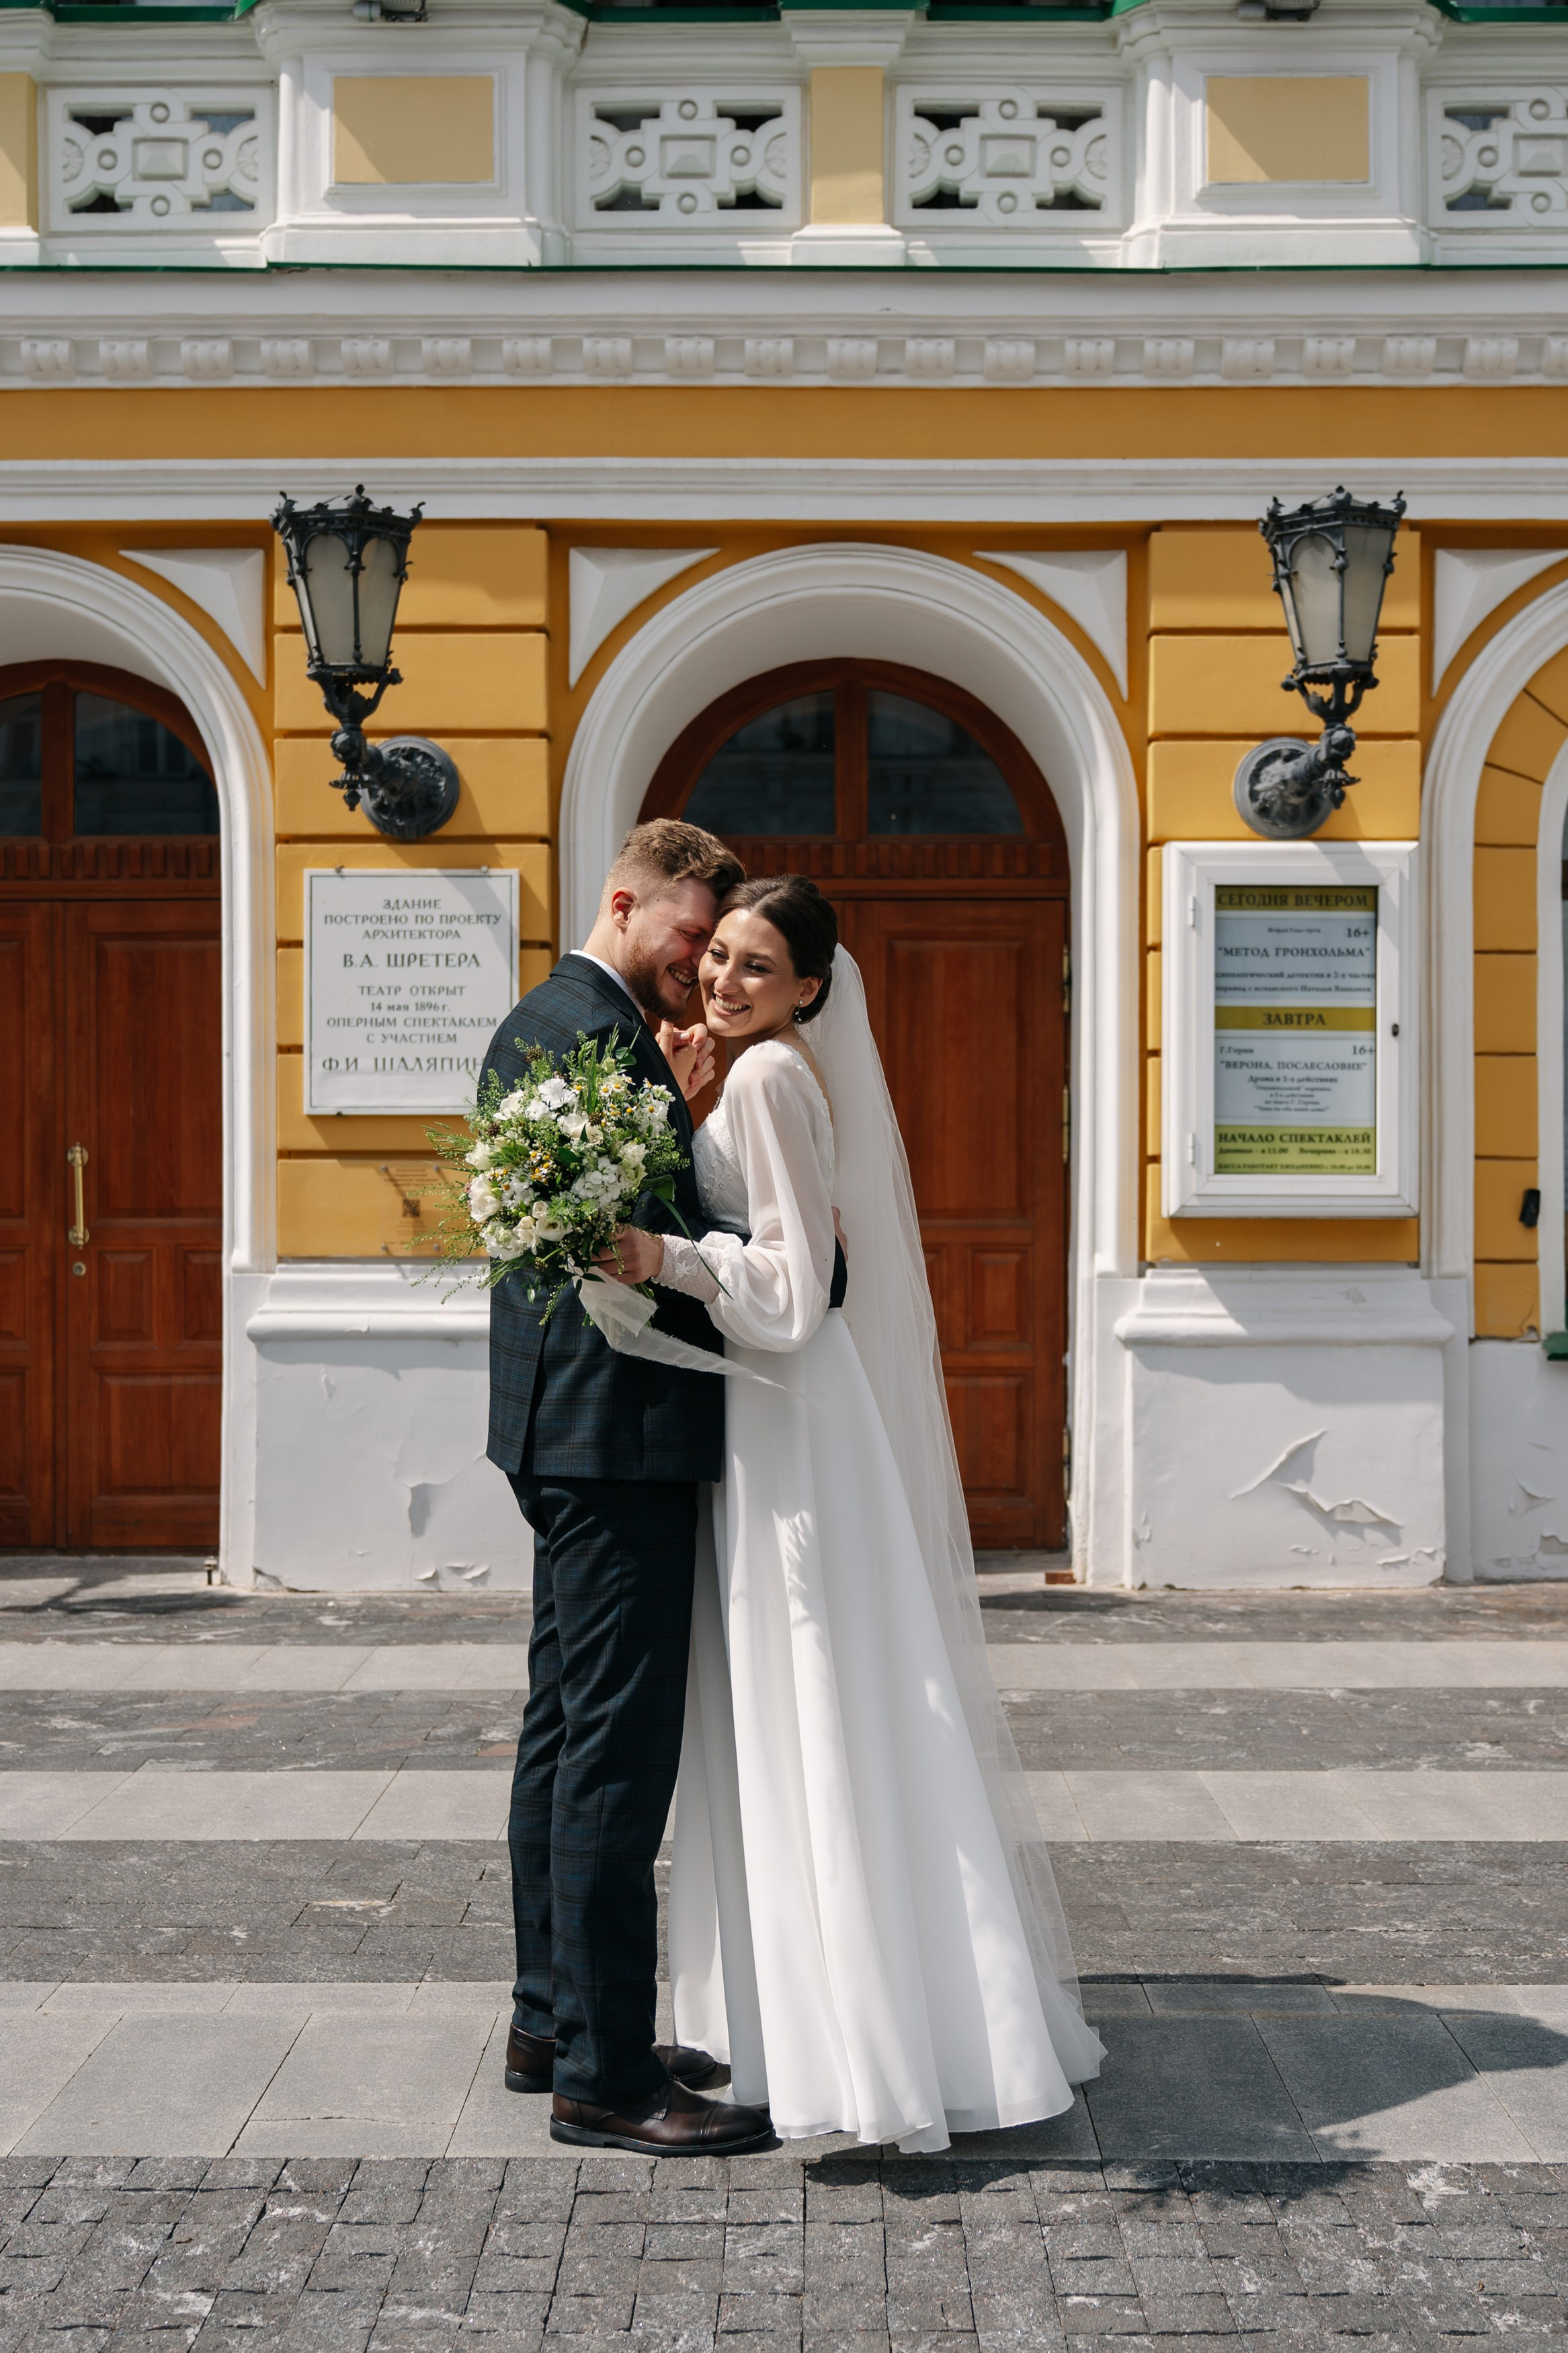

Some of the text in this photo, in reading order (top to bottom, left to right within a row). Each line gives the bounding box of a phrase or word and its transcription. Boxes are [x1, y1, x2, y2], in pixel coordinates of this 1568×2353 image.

[383, 900, 442, 910] ЗДАНИЕ
[1218, 893, 1368, 907] СЕГОДНЯ ВЕЧЕРОМ
[325, 915, 501, 924] ПОСТРОЕНО ПО ПРОЕКТУ
[363, 930, 460, 939] АРХИТЕКТОРА
[1347, 928, 1369, 937] 16+
[387, 954, 481, 967] ШРЕТЕРА
[358, 986, 466, 996] ТЕАТР ОТКРЫТ
[371, 1002, 382, 1011] 14
[327, 1018, 497, 1027] ОПЕРНЫМ СПЕКТАКЛЕМ
[1263, 1014, 1325, 1025] ЗАВТРА
[367, 1034, 457, 1043] С УЧАСТИЕМ
[1352, 1045, 1375, 1055] 16+
[374, 1057, 484, 1072] ШАЛЯПИН
[1219, 1133, 1370, 1143] НАЧАЛО СПЕКТАКЛЕЙ
